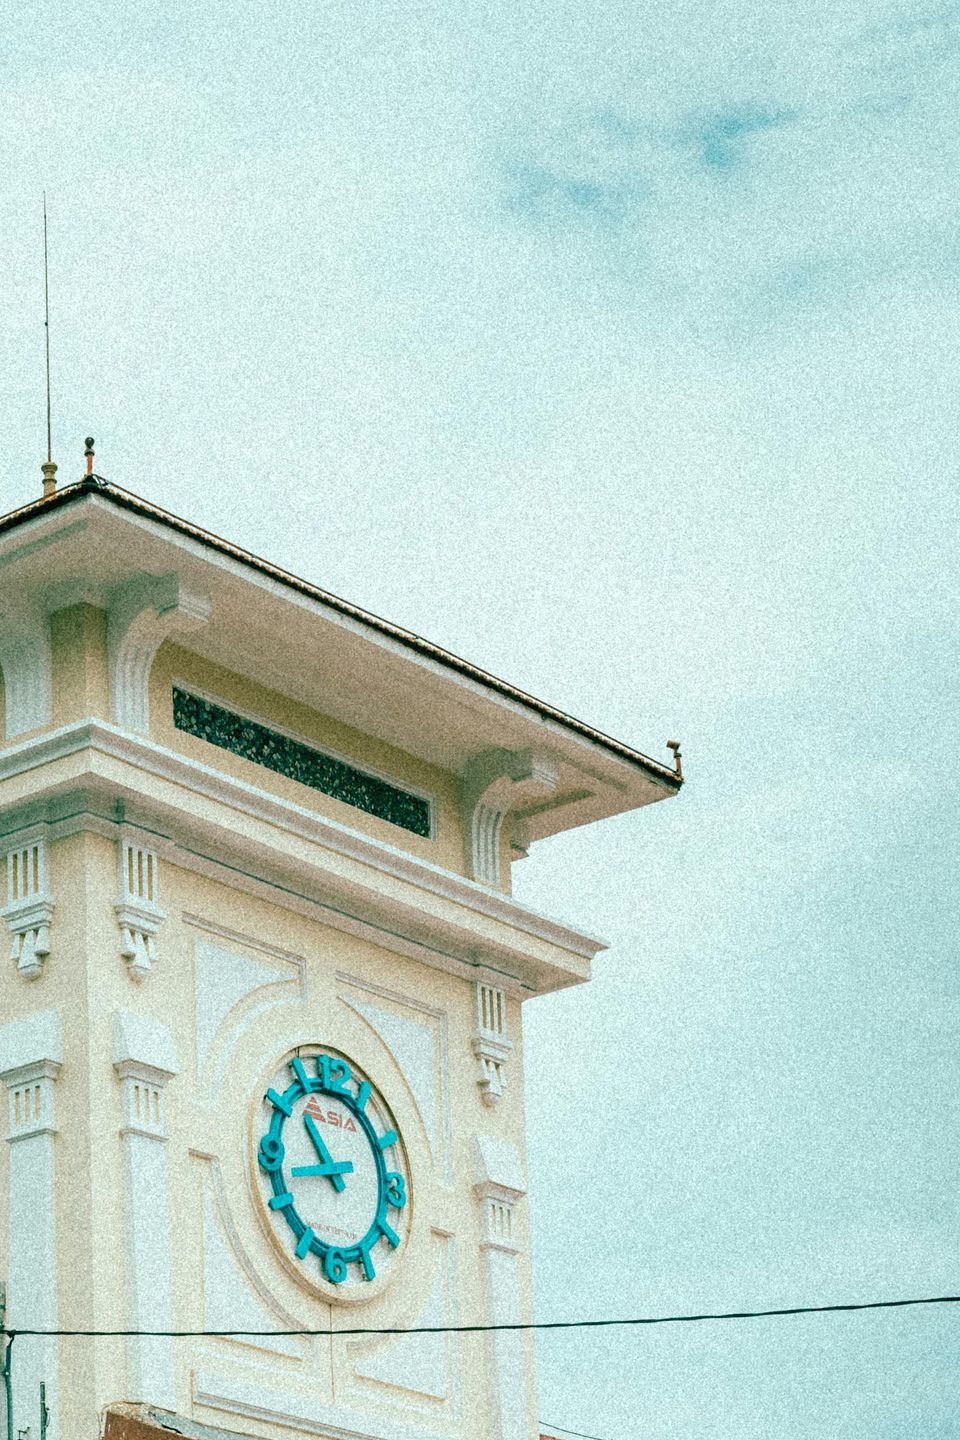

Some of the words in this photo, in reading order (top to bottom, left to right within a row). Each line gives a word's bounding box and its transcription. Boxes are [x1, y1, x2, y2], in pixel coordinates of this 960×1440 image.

[317, 1054, 352, 1095] 12
[258, 1133, 285, 1171] 9
[385, 1171, 407, 1209] 3
[324, 1246, 348, 1284] 6
